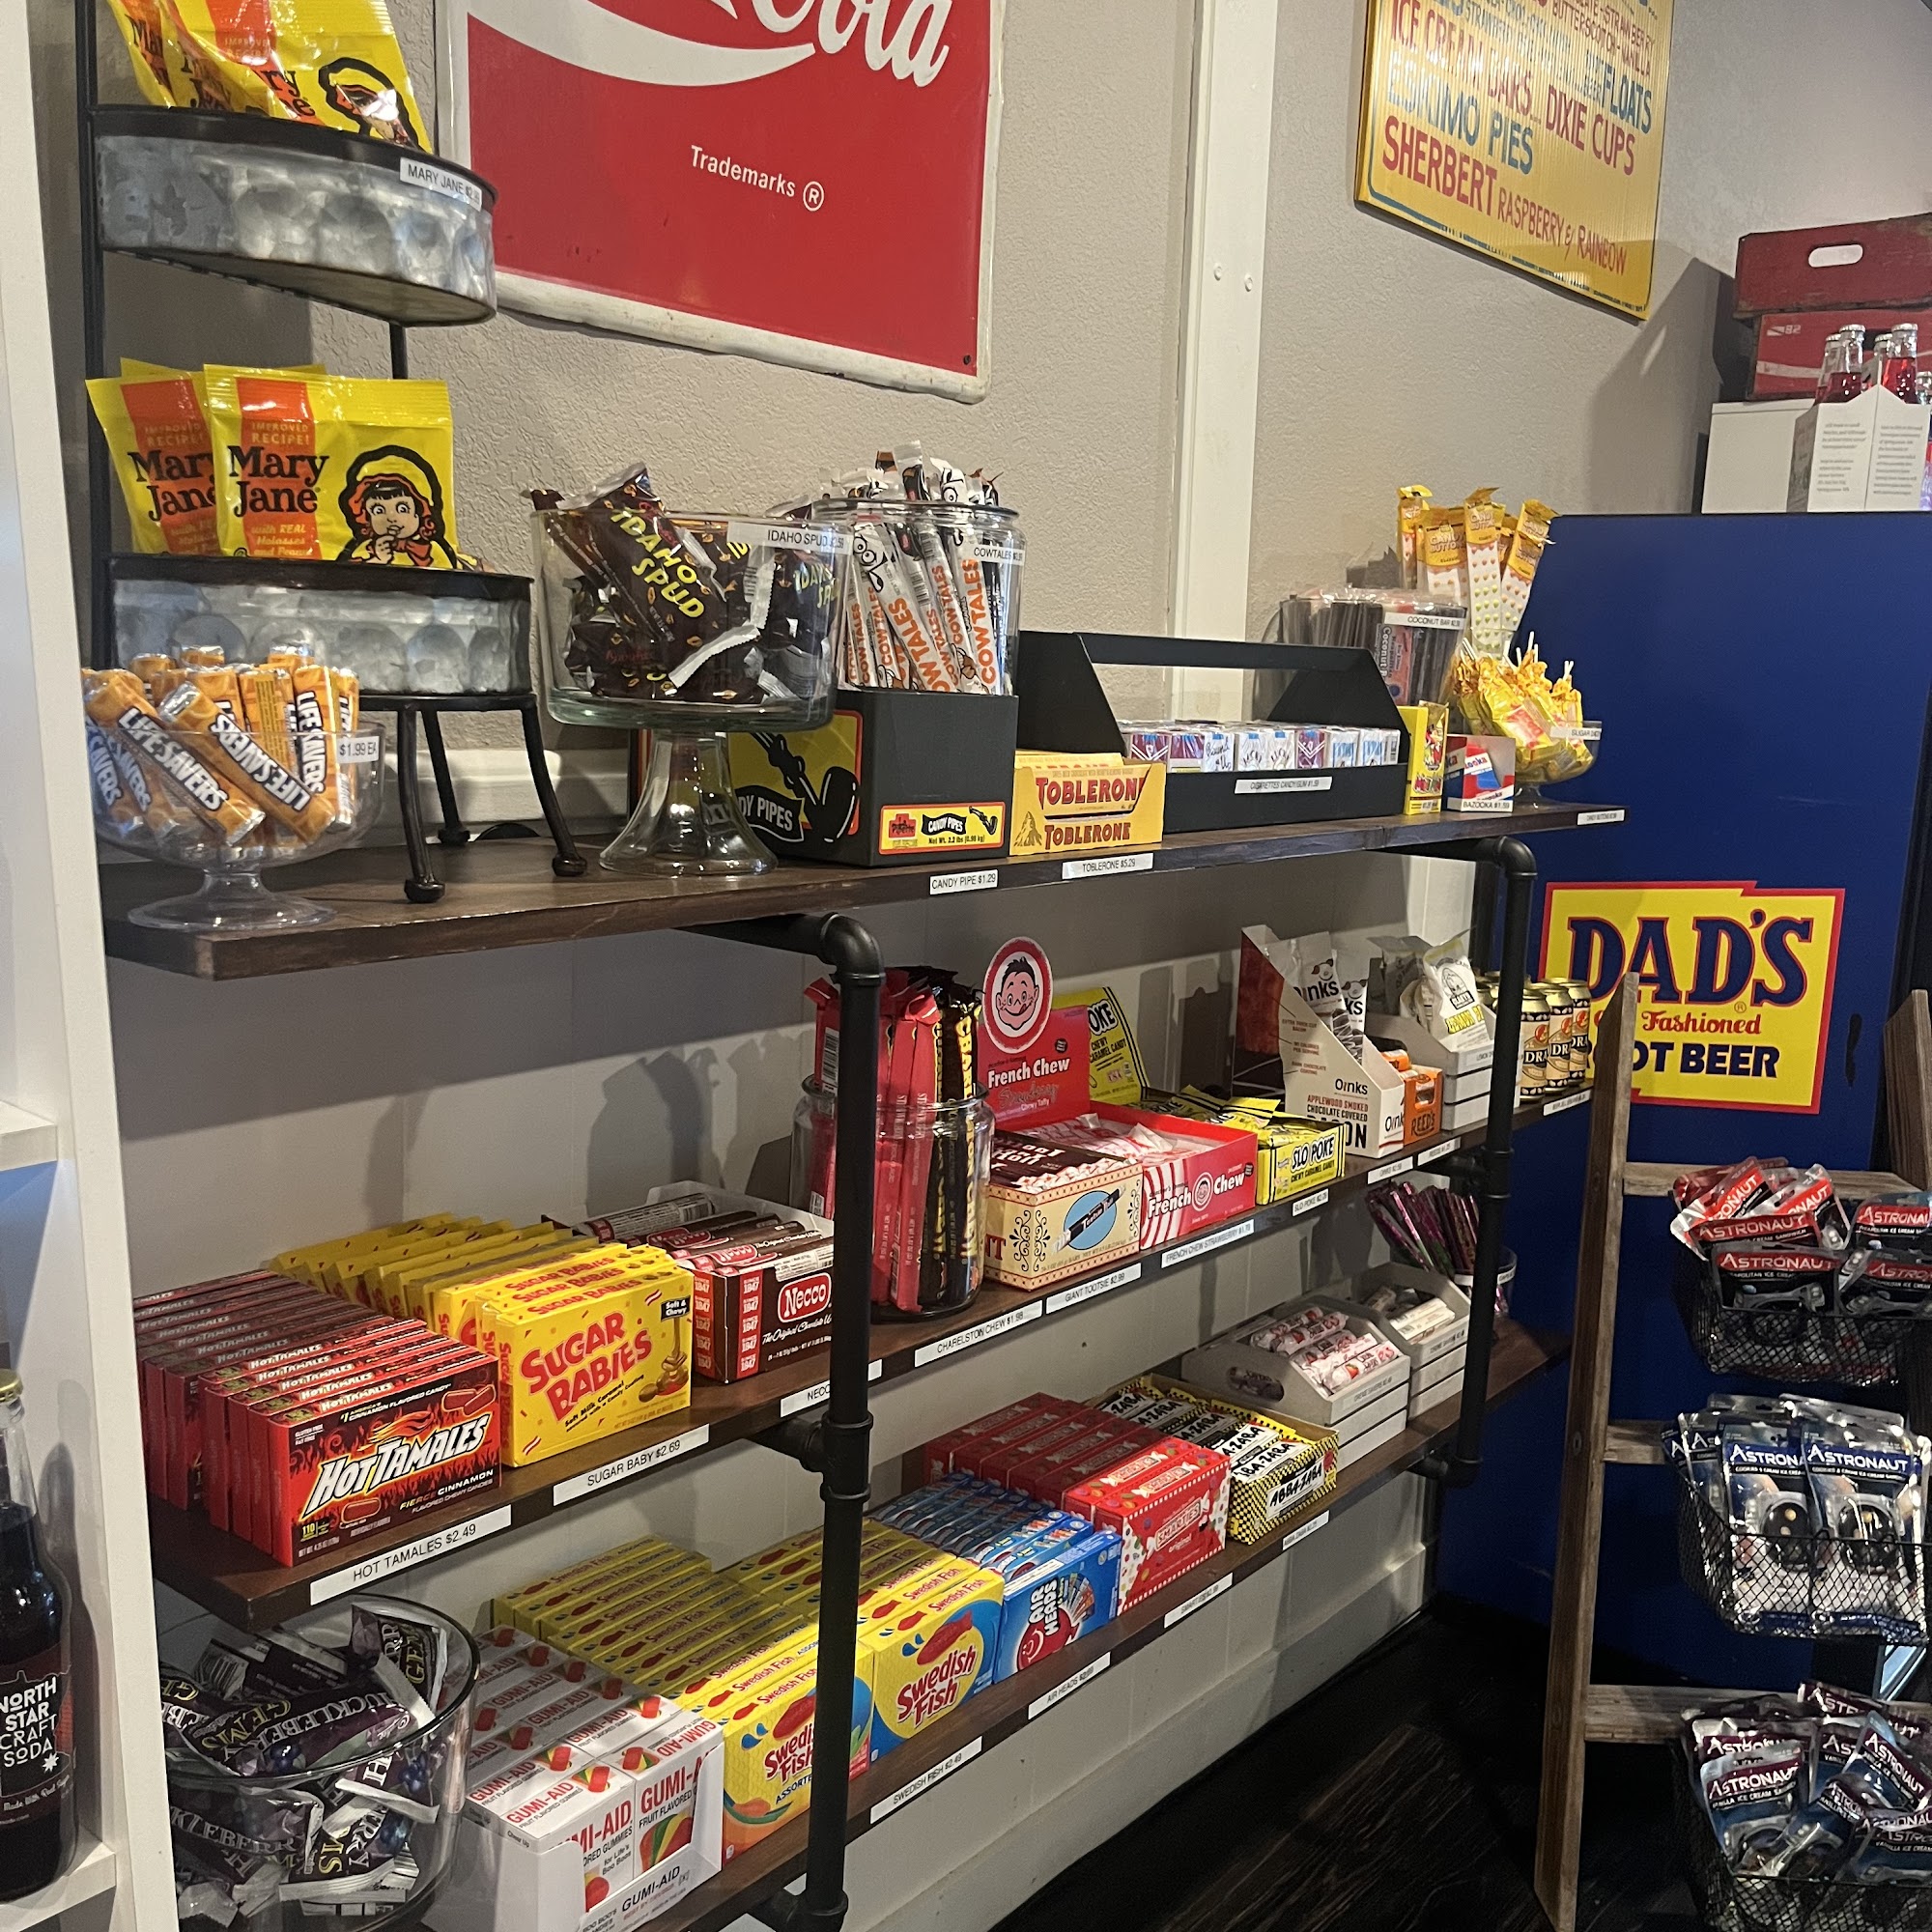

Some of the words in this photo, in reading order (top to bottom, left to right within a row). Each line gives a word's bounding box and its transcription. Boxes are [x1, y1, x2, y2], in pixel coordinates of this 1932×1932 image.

[1387, 48, 1480, 147] ESKIMO
[1488, 110, 1534, 176] PIES
[1601, 62, 1652, 134] FLOATS
[1546, 84, 1588, 153] DIXIE
[1593, 114, 1636, 177] CUPS
[409, 164, 439, 185] MARY
[440, 177, 464, 195] JANE
[691, 144, 796, 198] Trademarks
[1382, 115, 1498, 217] SHERBERT
[1497, 186, 1565, 248] RASPBERRY
[1577, 225, 1628, 276] RAINBOW
[251, 434, 310, 445] RECIPE!
[252, 422, 309, 433] IMPROVED
[227, 445, 329, 487] Mary
[234, 481, 318, 518] Jane
[279, 525, 306, 534] REAL
[611, 508, 697, 585] IDAHO
[768, 529, 803, 544] IDAHO
[804, 533, 828, 547] SPUD
[631, 557, 705, 618] SPUD
[961, 557, 986, 628] TALES
[888, 597, 931, 663] TALES
[1407, 614, 1440, 626] COCONUT
[878, 629, 893, 666] COW
[975, 629, 996, 685] COW
[1380, 626, 1392, 668] Coconut
[339, 743, 366, 757] $1.99
[756, 798, 794, 832] PIPES
[1463, 800, 1494, 810] BAZOOKA
[928, 817, 948, 833] CANDY
[947, 817, 964, 832] PIPES
[1043, 822, 1132, 850] TOBLERONE
[931, 878, 957, 890] CANDY
[959, 875, 977, 887] PIPE
[978, 872, 996, 884] $1.29
[1082, 860, 1121, 872] TOBLERONE
[1121, 857, 1136, 868] $5.29
[1567, 908, 1815, 1008] DAD'S
[1641, 1009, 1762, 1036] Fashioned
[987, 1064, 1032, 1090] French
[1033, 1057, 1071, 1081] Chew
[1679, 1042, 1780, 1079] BEER
[1307, 1094, 1343, 1109] APPLEWOOD
[1343, 1100, 1369, 1113] SMOKED
[1334, 1078, 1369, 1095] Oinks
[1306, 1103, 1341, 1118] CHOCOLATE
[1341, 1110, 1368, 1122] COVERED
[1292, 1146, 1309, 1170] SLO
[1310, 1135, 1335, 1163] POKE
[1148, 1186, 1192, 1219] French
[1213, 1173, 1245, 1195] Chew
[1699, 1212, 1806, 1239] ASTRONAUT
[719, 1244, 753, 1263] Necco
[1719, 1252, 1833, 1270] ASTRONAUT
[504, 1271, 558, 1292] SUGAR
[559, 1257, 615, 1276] BABIES
[512, 1283, 568, 1303] SUGAR
[569, 1267, 625, 1287] BABIES
[1065, 1288, 1084, 1302] GIANT
[1084, 1278, 1110, 1294] TOOTSIE
[527, 1294, 582, 1315] SUGAR
[583, 1279, 642, 1300] BABIES
[783, 1283, 827, 1319] Necco
[773, 1324, 798, 1342] Original
[985, 1320, 1006, 1333] CHEW
[520, 1311, 626, 1395] SUGAR
[546, 1329, 652, 1422] BABIES
[349, 1404, 389, 1422] CINNAMON
[388, 1391, 426, 1409] FLAVORED
[426, 1383, 452, 1398] CANDY
[564, 1415, 579, 1428] Soft
[580, 1402, 596, 1417] Milk
[597, 1380, 625, 1403] Caramel
[301, 1455, 377, 1520] HOT
[368, 1414, 493, 1494] TAMALES
[587, 1463, 625, 1487] SUGAR
[627, 1451, 654, 1470] BABY
[655, 1439, 681, 1459] $2.69
[1806, 1442, 1908, 1472] ASTRONAUT
[399, 1492, 436, 1511] FIERCE
[437, 1468, 495, 1496] CINNAMON
[412, 1497, 443, 1515] FLAVORED
[301, 1523, 316, 1536] 110
[1158, 1506, 1199, 1544] SMARTIES
[353, 1560, 382, 1582] HOT
[384, 1537, 442, 1569] TAMALES
[444, 1523, 476, 1545] $2.49
[1168, 1533, 1192, 1553] original
[902, 1577, 938, 1601] Swedish
[939, 1567, 961, 1583] Fish
[929, 1588, 964, 1612] Swedish
[965, 1577, 986, 1594] Fish
[1028, 1585, 1045, 1624] AIR
[1043, 1578, 1060, 1636] HEADS
[732, 1667, 773, 1691] Swedish
[773, 1656, 794, 1670] Fish
[897, 1645, 977, 1724] Swedish
[1046, 1690, 1058, 1704] AIR
[1058, 1677, 1079, 1695] HEADS
[756, 1680, 798, 1705] Swedish
[913, 1682, 958, 1729] Fish
[5, 1701, 50, 1732] STAR
[567, 1707, 630, 1745] GUMI-AID
[3, 1737, 53, 1768] SODA
[1864, 1732, 1924, 1794] ASTRONAUT
[469, 1761, 537, 1802] GUMI-AID
[893, 1777, 927, 1805] SWEDISH
[926, 1766, 945, 1785] FISH
[1710, 1763, 1799, 1801] ASTRONAUT
[3, 1796, 24, 1811] Made
[506, 1781, 575, 1824] GUMI-AID
[534, 1802, 561, 1821] FLAVORED
[639, 1809, 659, 1830] FRUIT
[659, 1791, 694, 1817] FLAVORED
[602, 1825, 633, 1855] GUMMIES
[604, 1856, 613, 1866] for
[613, 1843, 630, 1860] Life's
[602, 1863, 615, 1876] Boo
[615, 1850, 632, 1866] Boos
[621, 1865, 680, 1913] GUMI-AID
